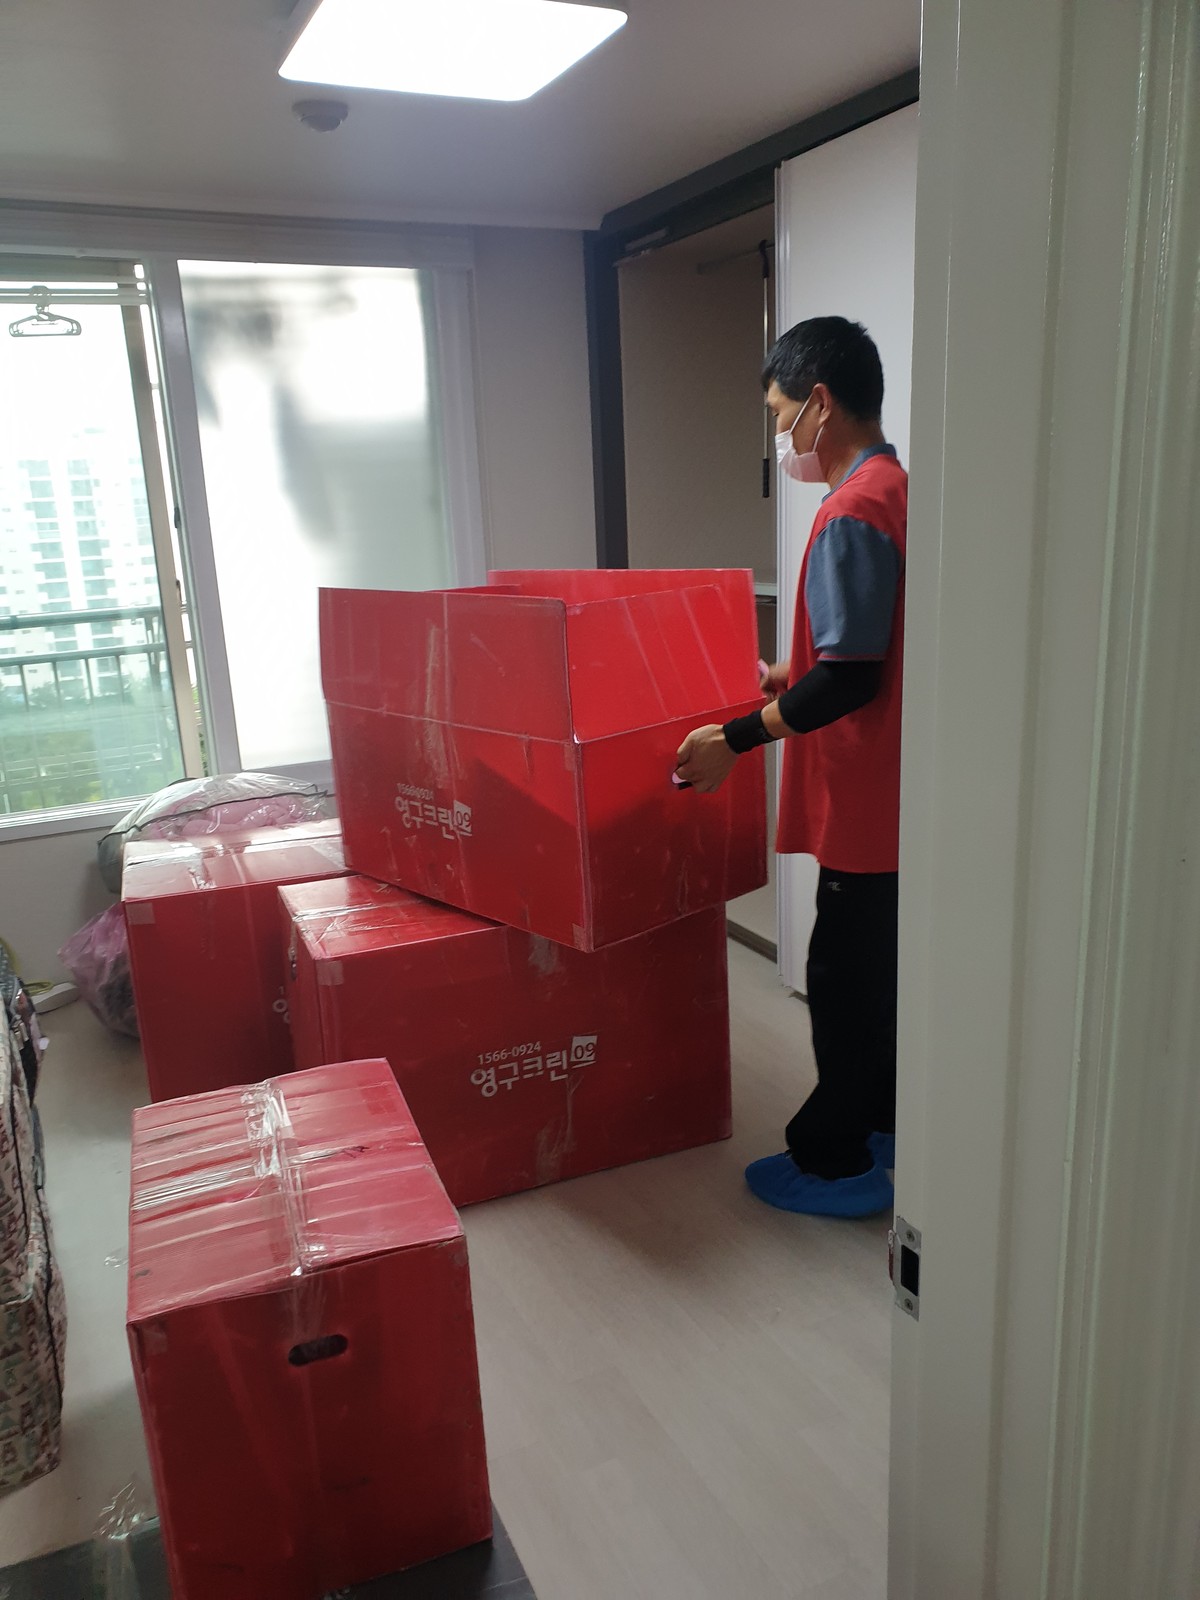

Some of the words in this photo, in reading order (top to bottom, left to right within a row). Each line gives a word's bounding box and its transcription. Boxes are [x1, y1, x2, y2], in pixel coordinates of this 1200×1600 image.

[394, 796, 455, 840] 영구크린
[470, 1049, 569, 1098] 영구크린
[477, 1041, 542, 1065] 1566-0924
